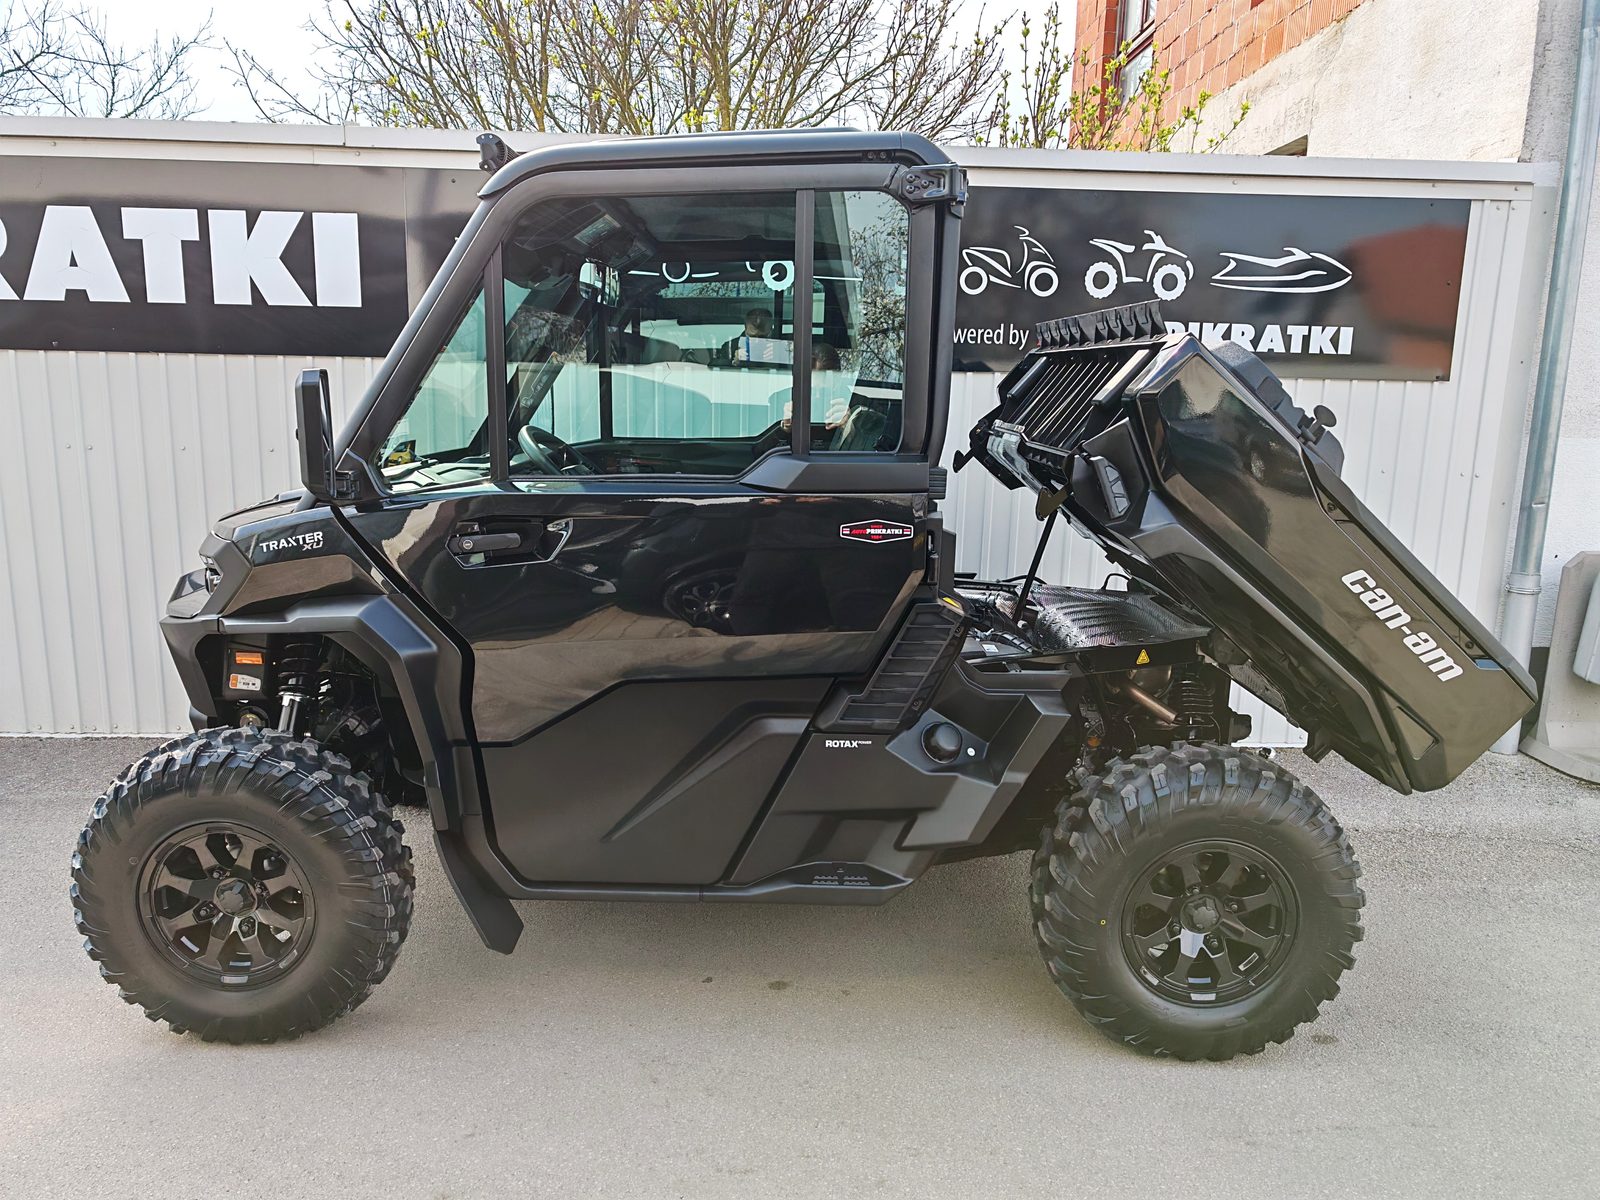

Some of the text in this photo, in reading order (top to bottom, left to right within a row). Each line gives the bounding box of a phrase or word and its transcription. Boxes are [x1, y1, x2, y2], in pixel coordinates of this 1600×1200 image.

[0, 205, 363, 308] ATKI
[1009, 323, 1029, 350] by
[259, 531, 323, 553] TRAXTER
[825, 740, 858, 748] ROTAX
